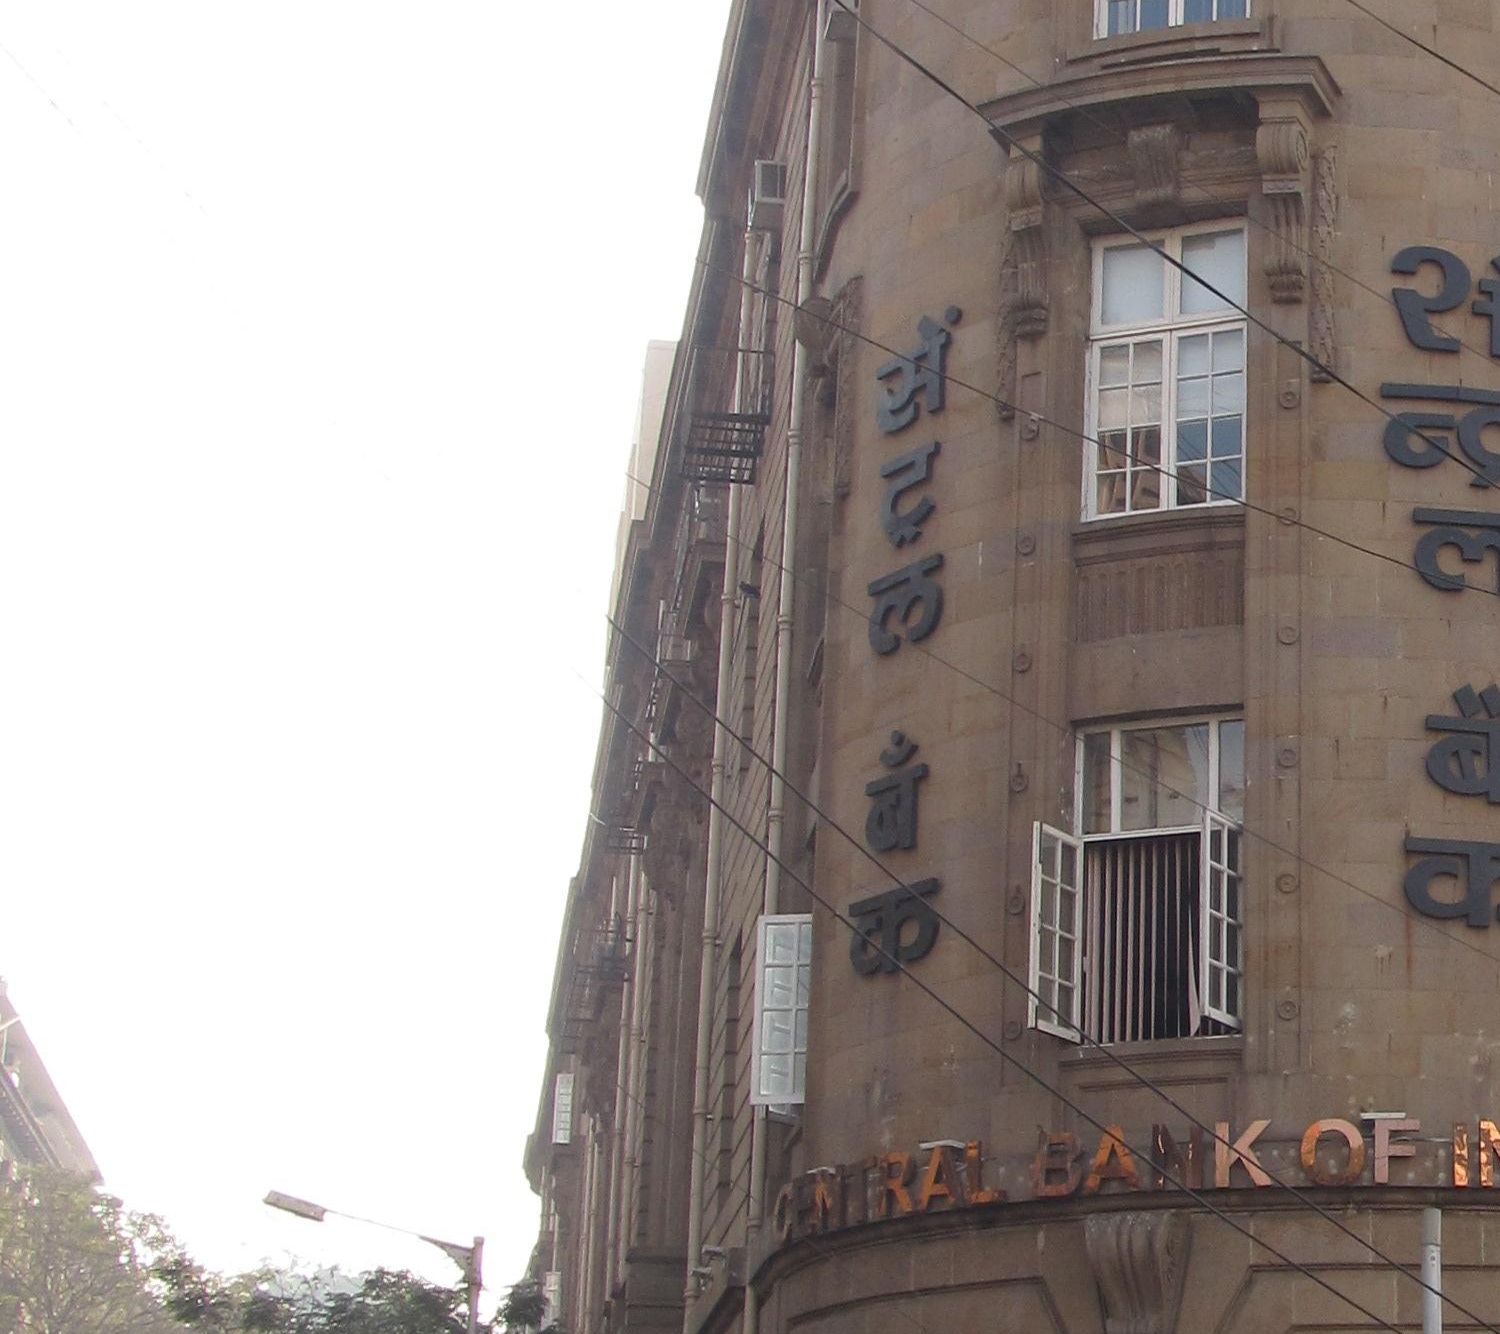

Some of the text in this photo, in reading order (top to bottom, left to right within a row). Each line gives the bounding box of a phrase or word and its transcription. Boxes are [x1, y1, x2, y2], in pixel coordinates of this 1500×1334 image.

[772, 1140, 1006, 1235] CENTRAL
[1031, 1119, 1272, 1199] BANK
[1301, 1117, 1421, 1187] OF
